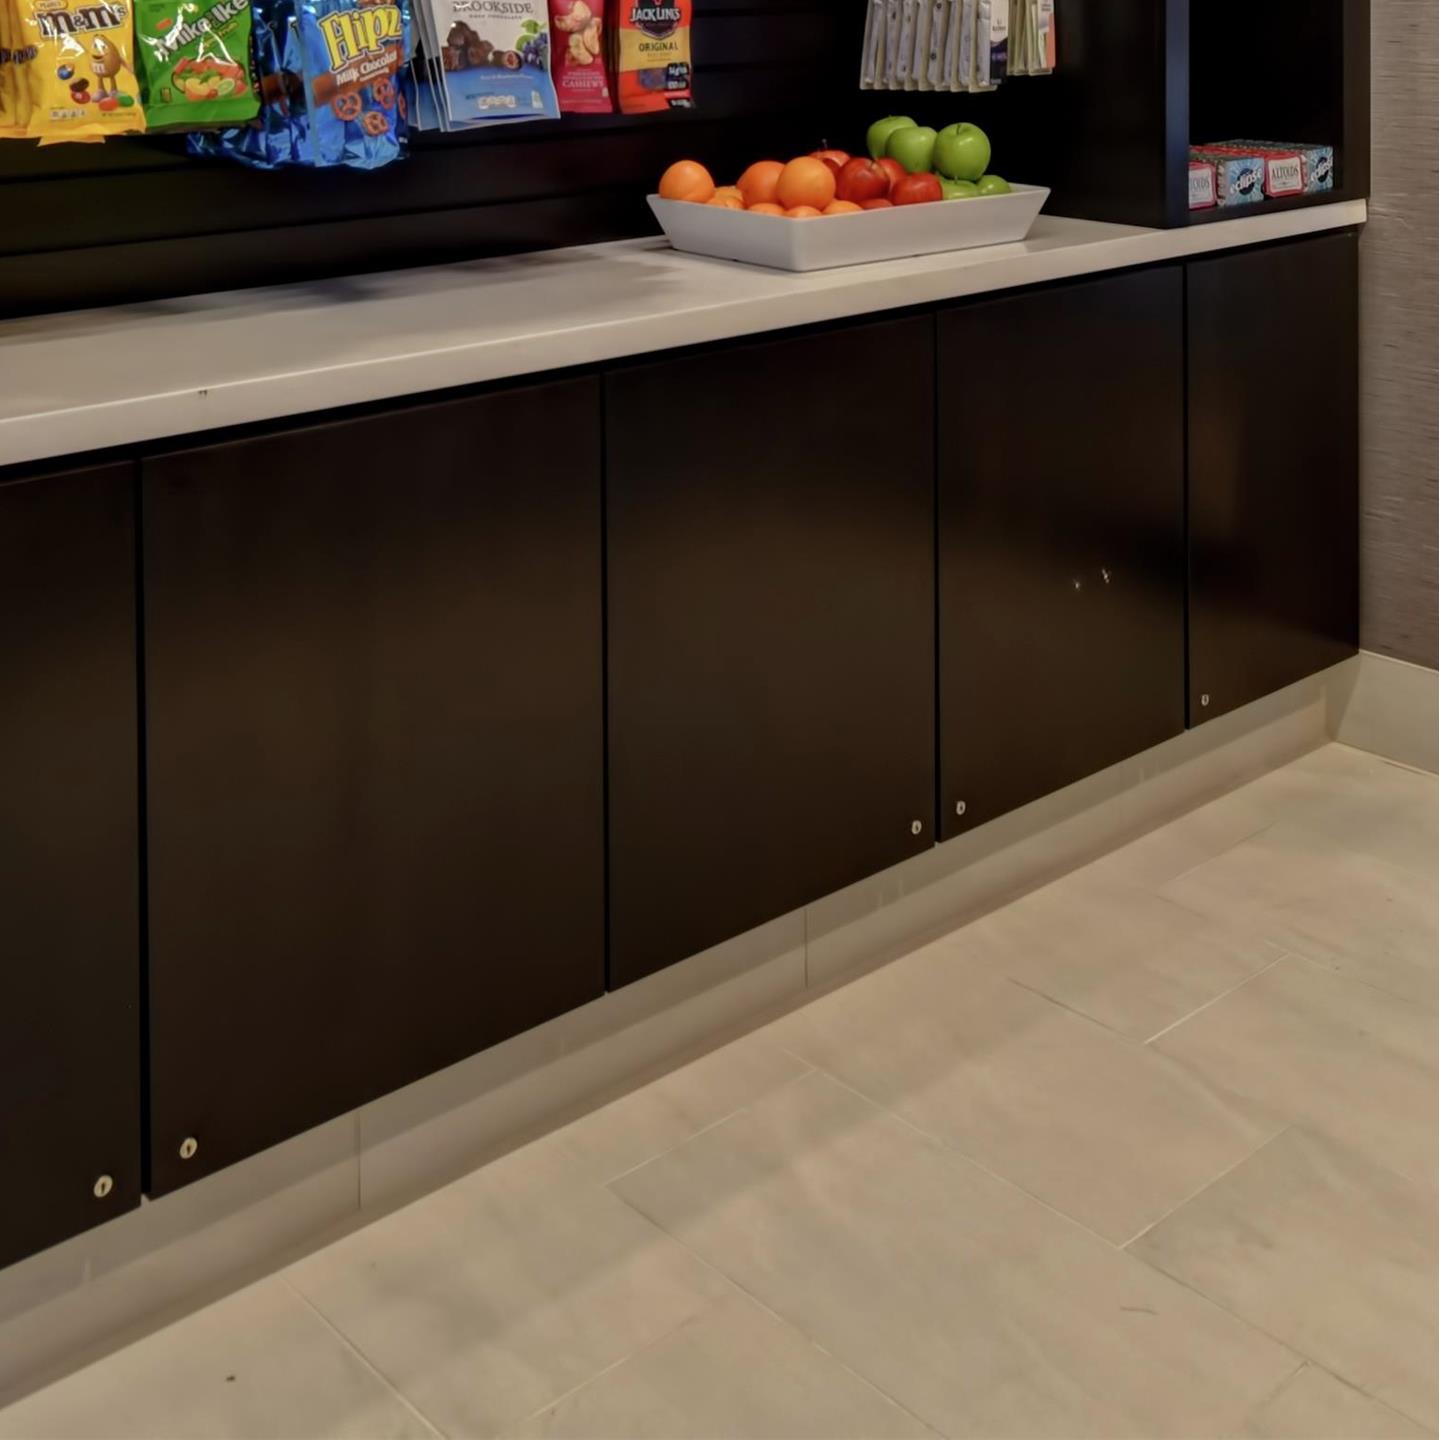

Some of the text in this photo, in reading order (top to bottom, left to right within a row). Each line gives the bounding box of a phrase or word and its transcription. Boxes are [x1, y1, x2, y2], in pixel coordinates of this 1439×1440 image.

[452, 0, 534, 14] BROOKSIDE
[318, 6, 402, 72] Flipz
[638, 41, 680, 52] ORIGINAL
